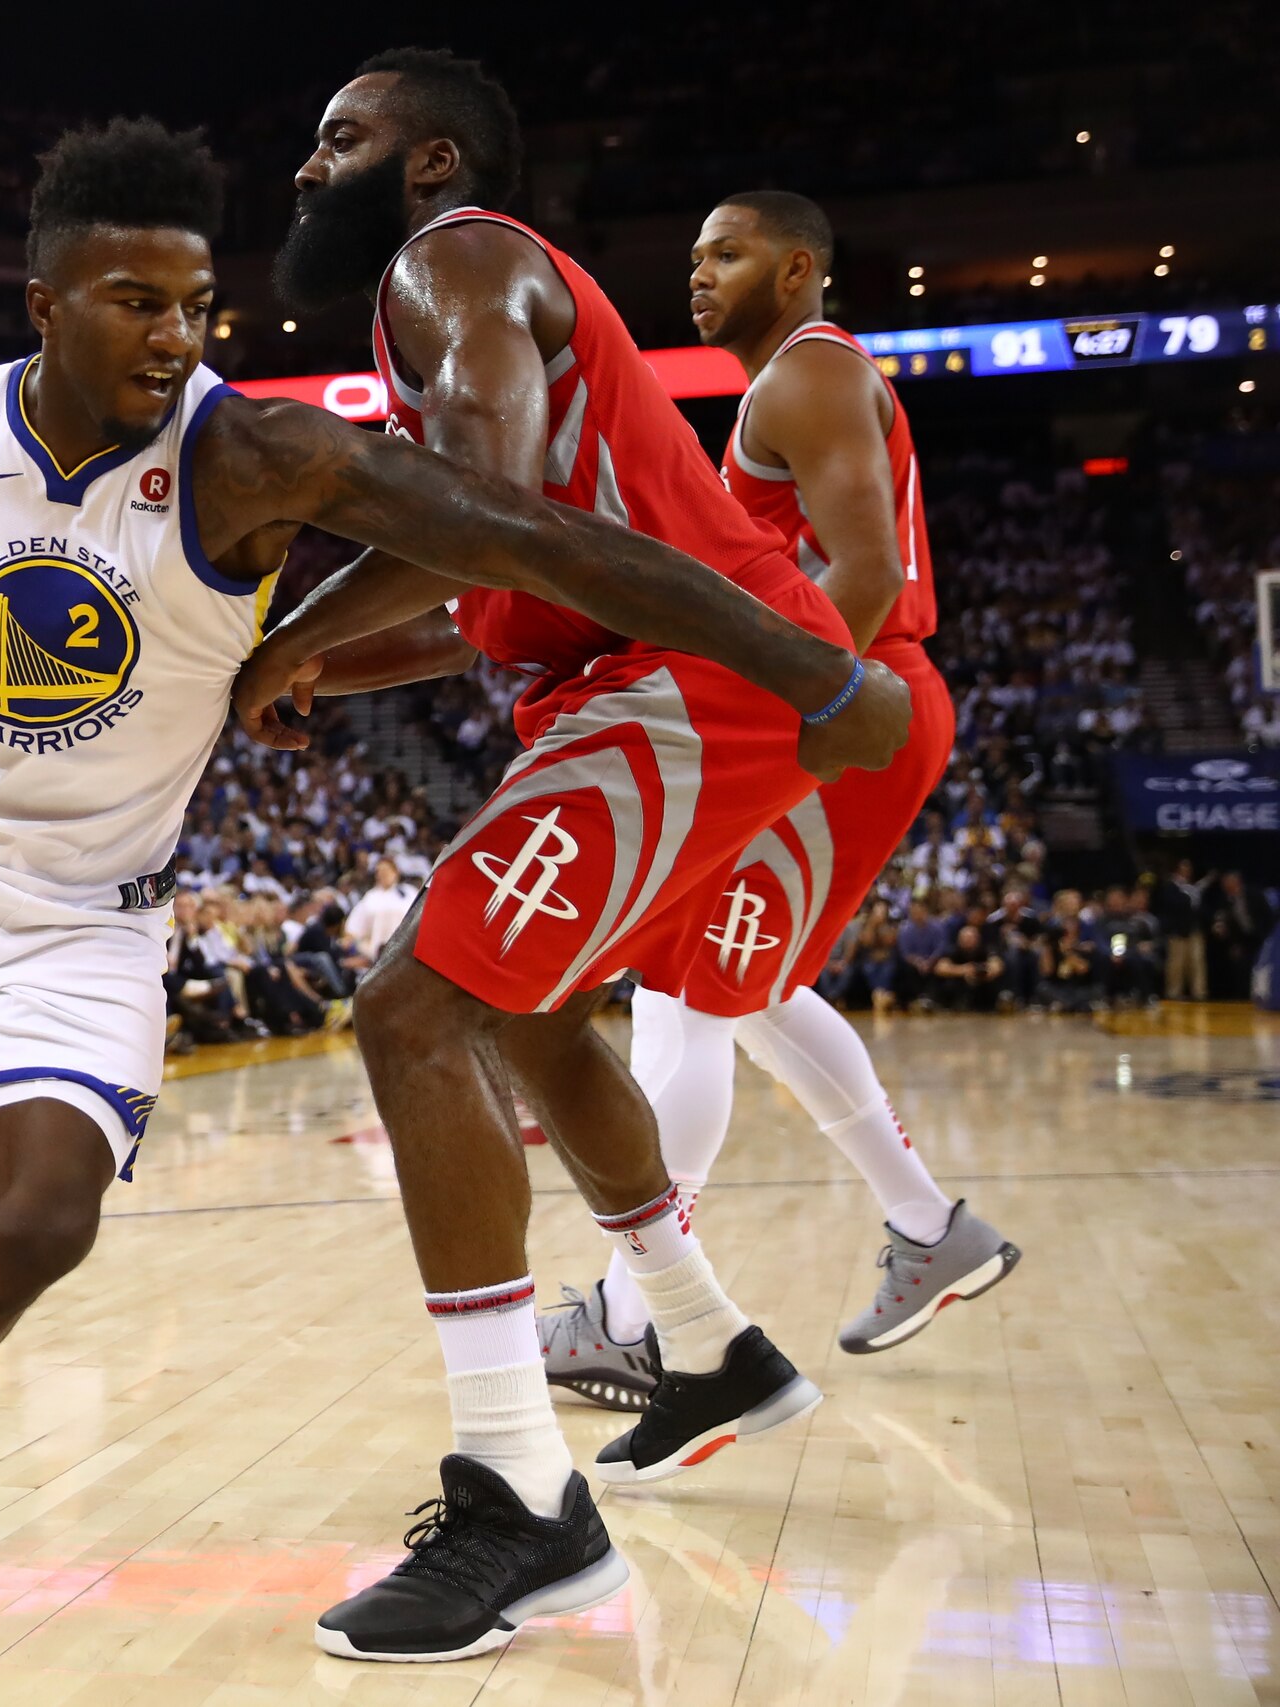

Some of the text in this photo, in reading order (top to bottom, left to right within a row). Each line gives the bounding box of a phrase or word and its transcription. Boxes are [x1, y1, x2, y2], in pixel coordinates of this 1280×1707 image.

[991, 328, 1047, 367] 91
[1159, 315, 1220, 356] 79
[149, 475, 163, 496] R
[130, 500, 169, 514] Rakuten
[76, 546, 141, 606] STATE
[65, 603, 100, 649] 2
[1156, 802, 1279, 830] CHASE
